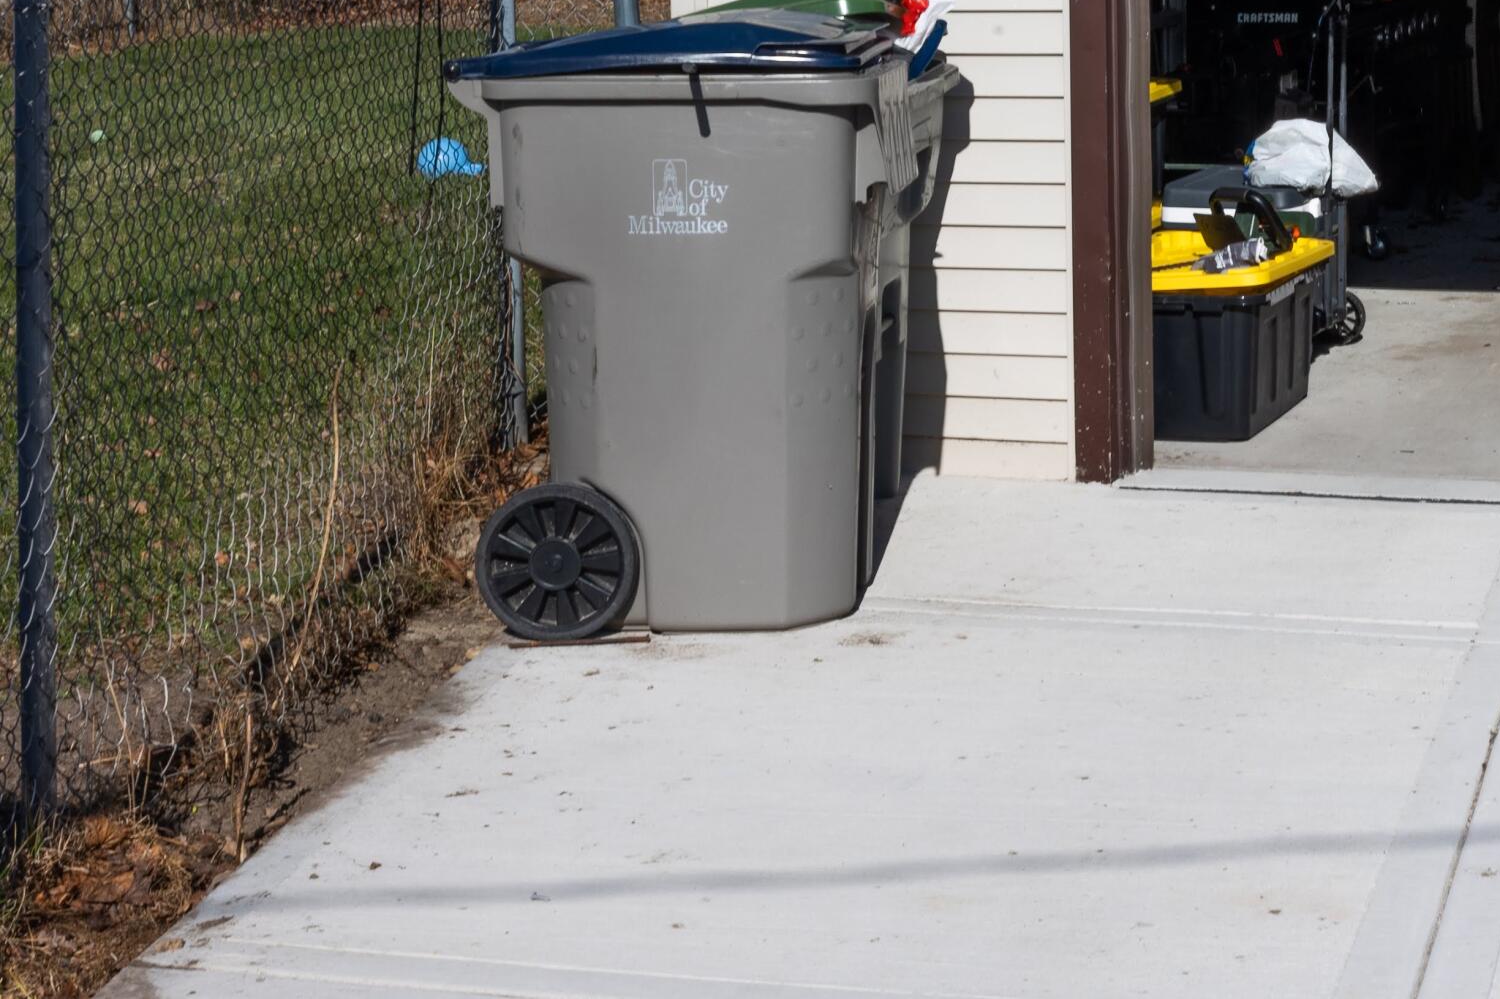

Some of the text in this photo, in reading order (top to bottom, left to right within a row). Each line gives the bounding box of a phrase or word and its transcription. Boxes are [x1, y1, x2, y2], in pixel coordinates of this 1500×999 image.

[1237, 12, 1299, 24] CRAFTSMAN
[689, 179, 728, 203] City
[689, 199, 708, 217] of
[628, 216, 728, 235] Milwaukee
